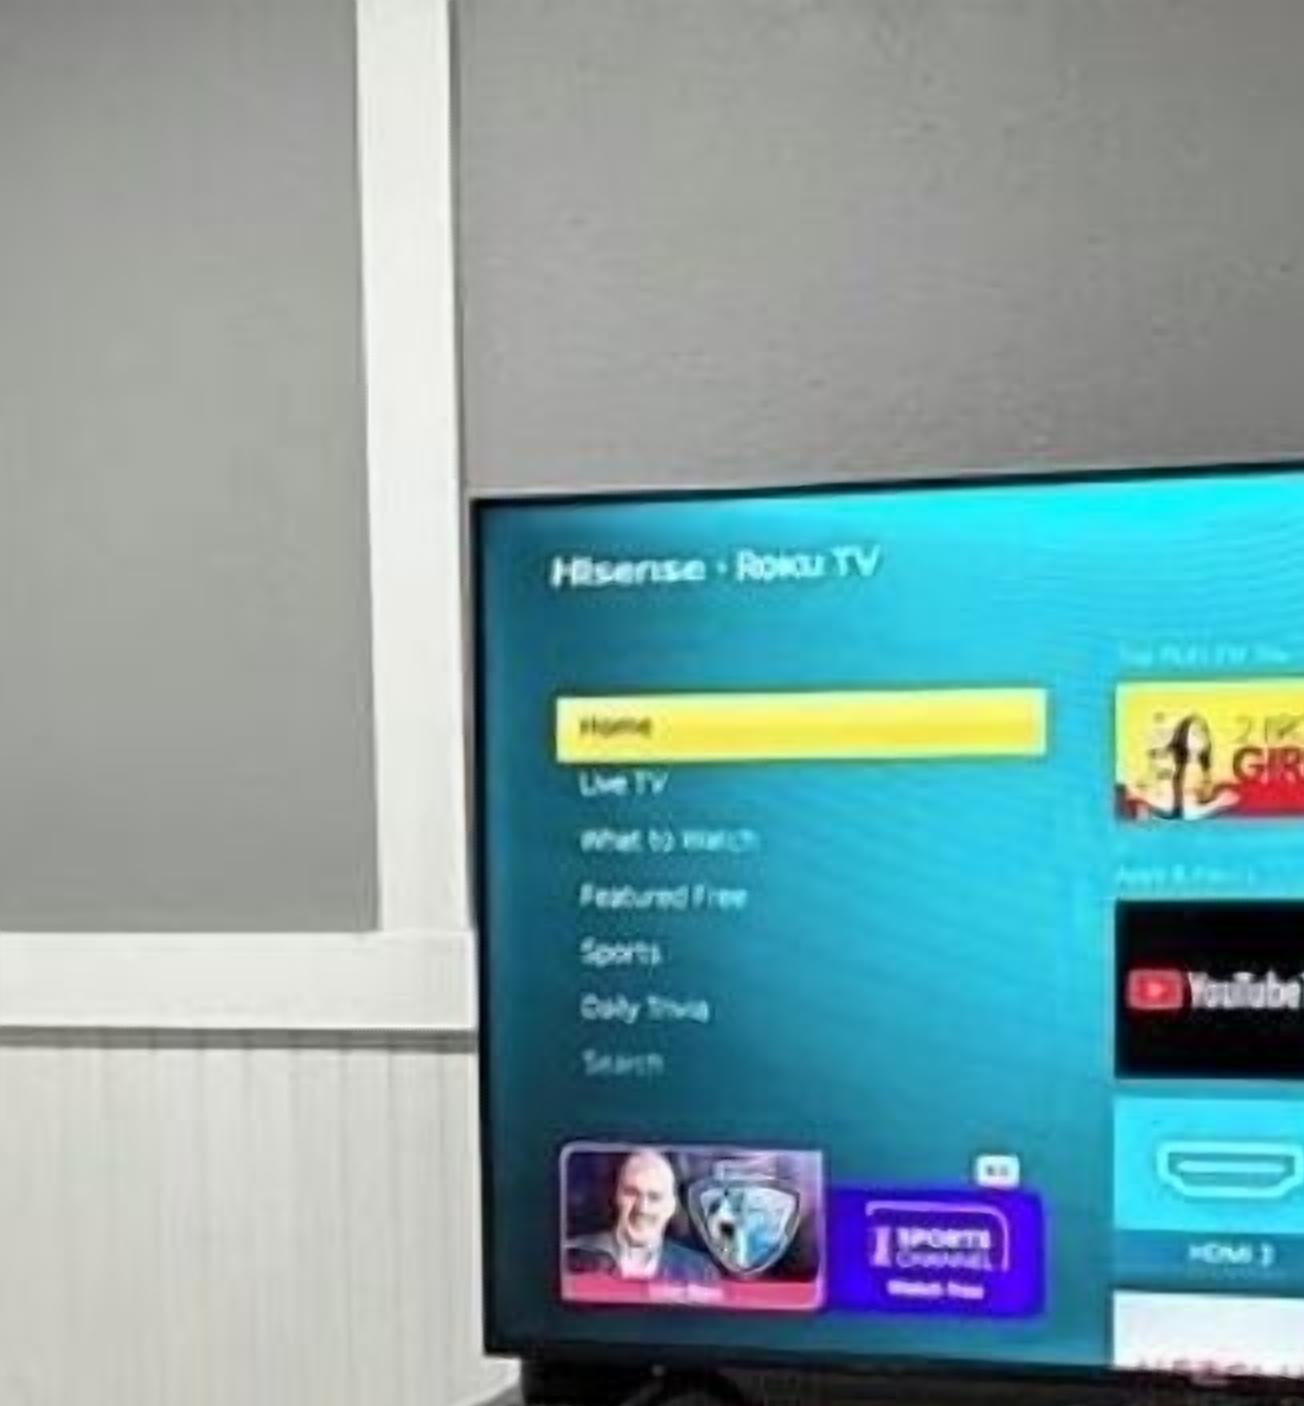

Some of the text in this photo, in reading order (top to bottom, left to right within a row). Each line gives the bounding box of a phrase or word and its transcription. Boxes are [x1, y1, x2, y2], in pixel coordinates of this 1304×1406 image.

[551, 546, 881, 588] Hisense Roku TV
[579, 717, 653, 740] Home
[579, 770, 669, 797] Live TV
[579, 883, 689, 911] Featured
[579, 936, 662, 969] Sports
[897, 1226, 991, 1250] SPORTS
